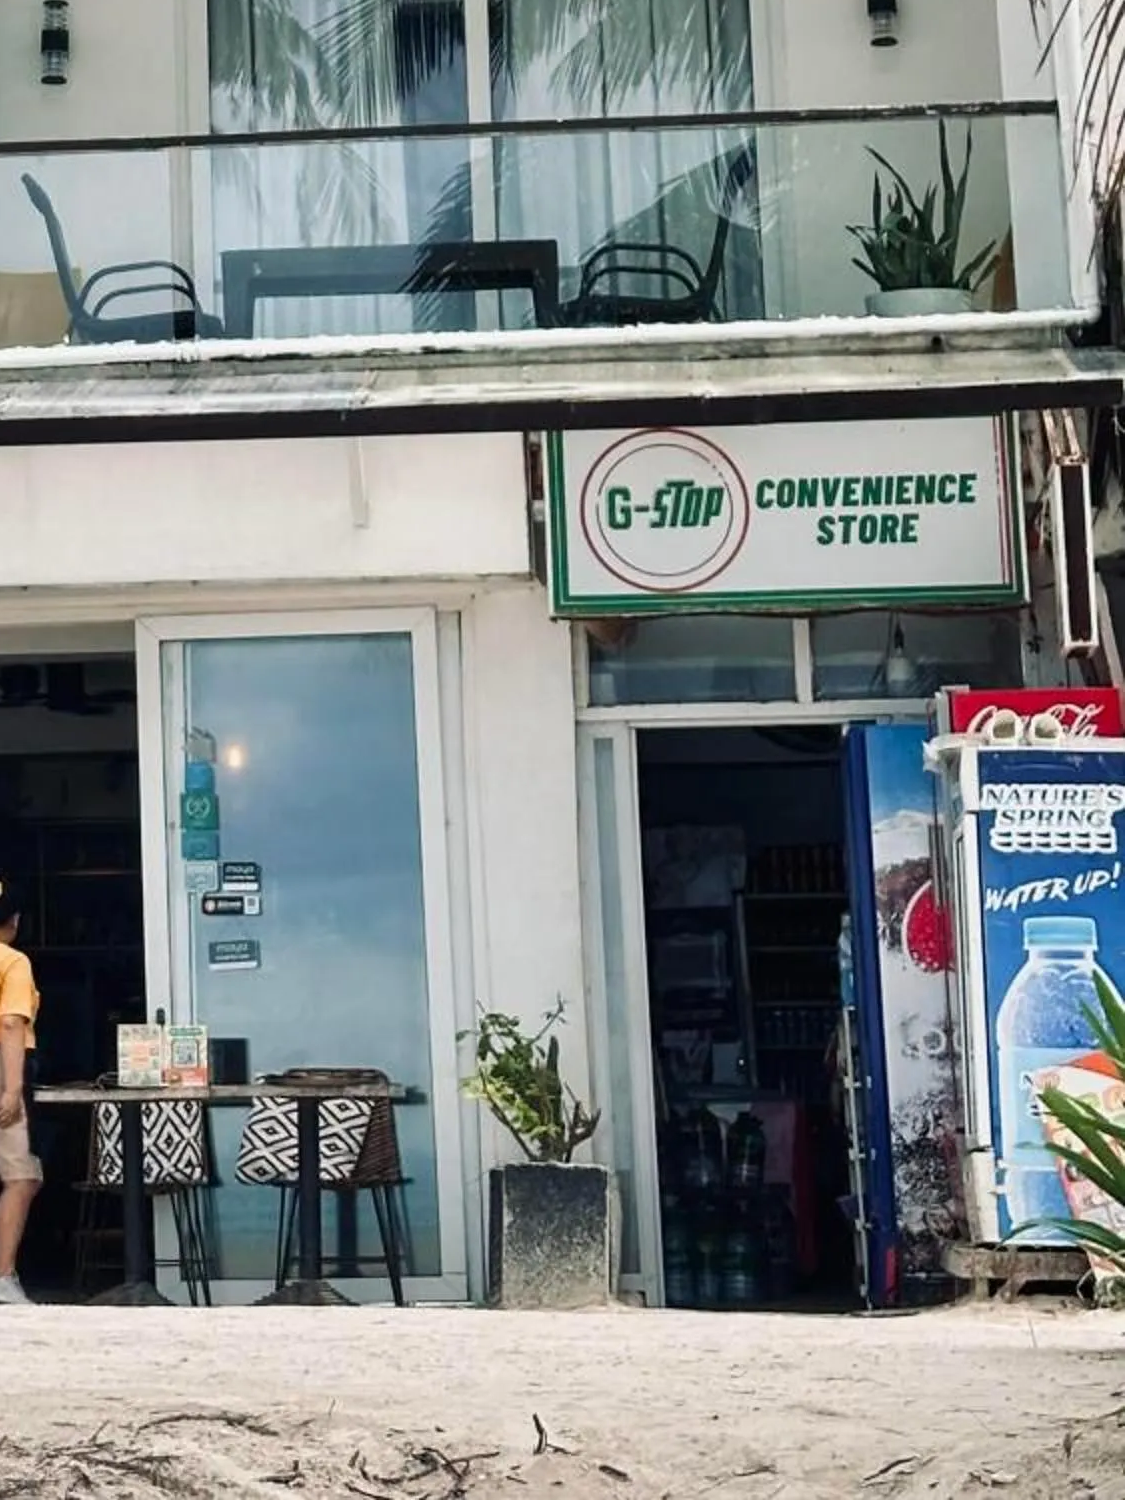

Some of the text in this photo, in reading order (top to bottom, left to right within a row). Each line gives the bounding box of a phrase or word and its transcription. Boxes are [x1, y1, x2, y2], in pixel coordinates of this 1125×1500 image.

[755, 472, 978, 510] CONVENIENCE
[816, 513, 920, 545] STORE
[986, 786, 1124, 806] NATURE'S
[999, 809, 1107, 829] SPRING
[985, 861, 1122, 914] WATER UP!
